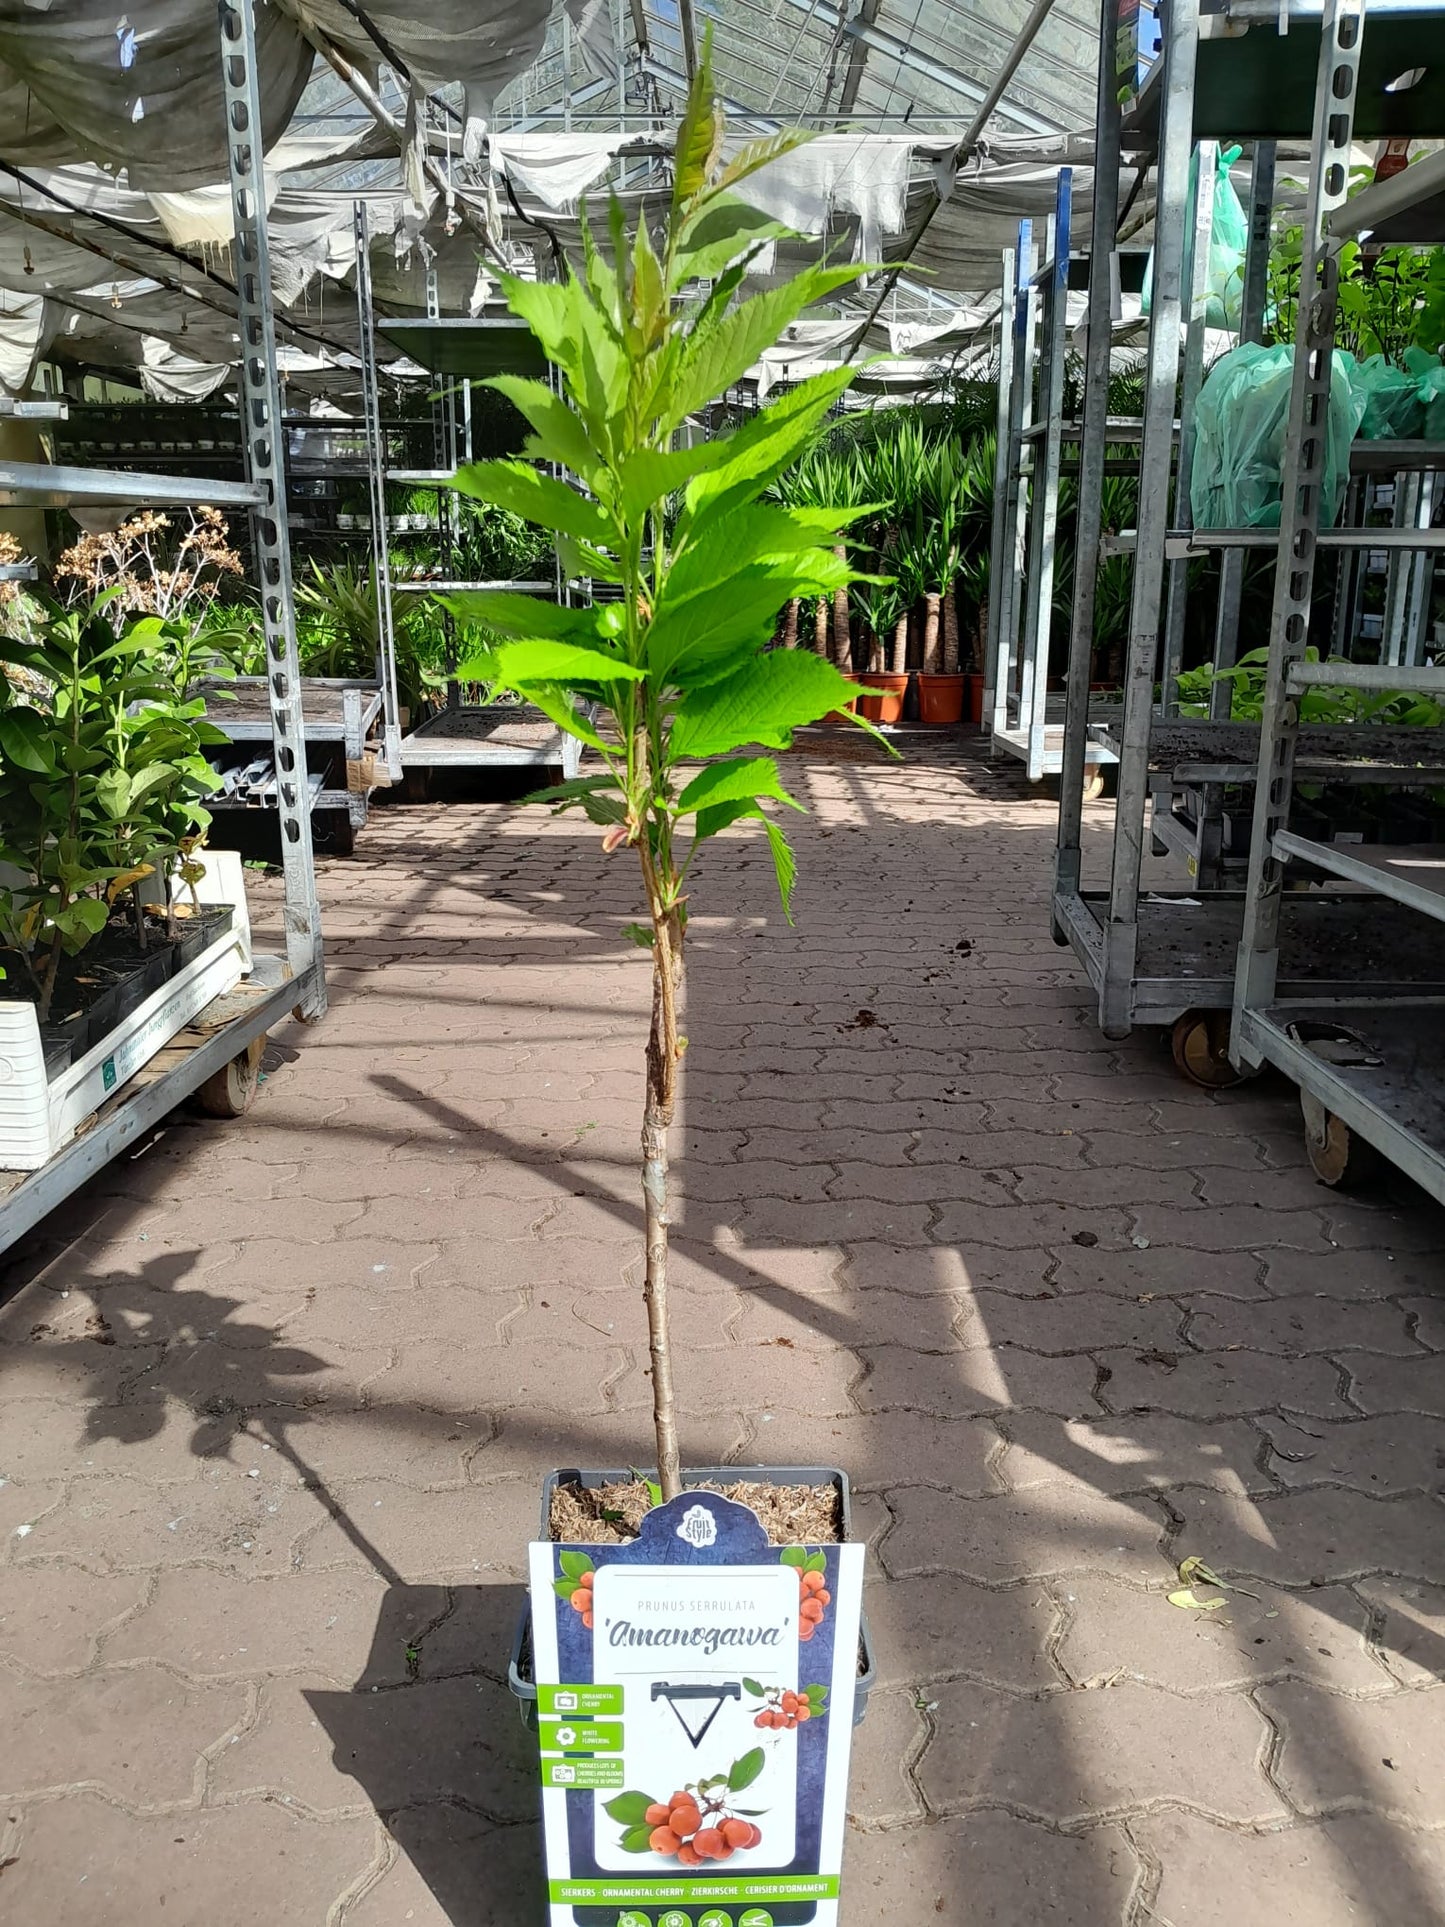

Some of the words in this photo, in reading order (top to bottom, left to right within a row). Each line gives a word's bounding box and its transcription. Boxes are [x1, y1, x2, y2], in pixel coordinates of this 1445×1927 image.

[638, 1600, 685, 1612] PRUNUS
[689, 1600, 756, 1612] SERRULATA
[561, 1888, 596, 1897] SIERKERS
[602, 1888, 654, 1897] ORNAMENTAL
[655, 1887, 685, 1897] CHERRY
[691, 1886, 738, 1896] ZIERKIRSCHE
[745, 1885, 778, 1895] CERISIER
[780, 1883, 829, 1894] D'ORNAMENT
